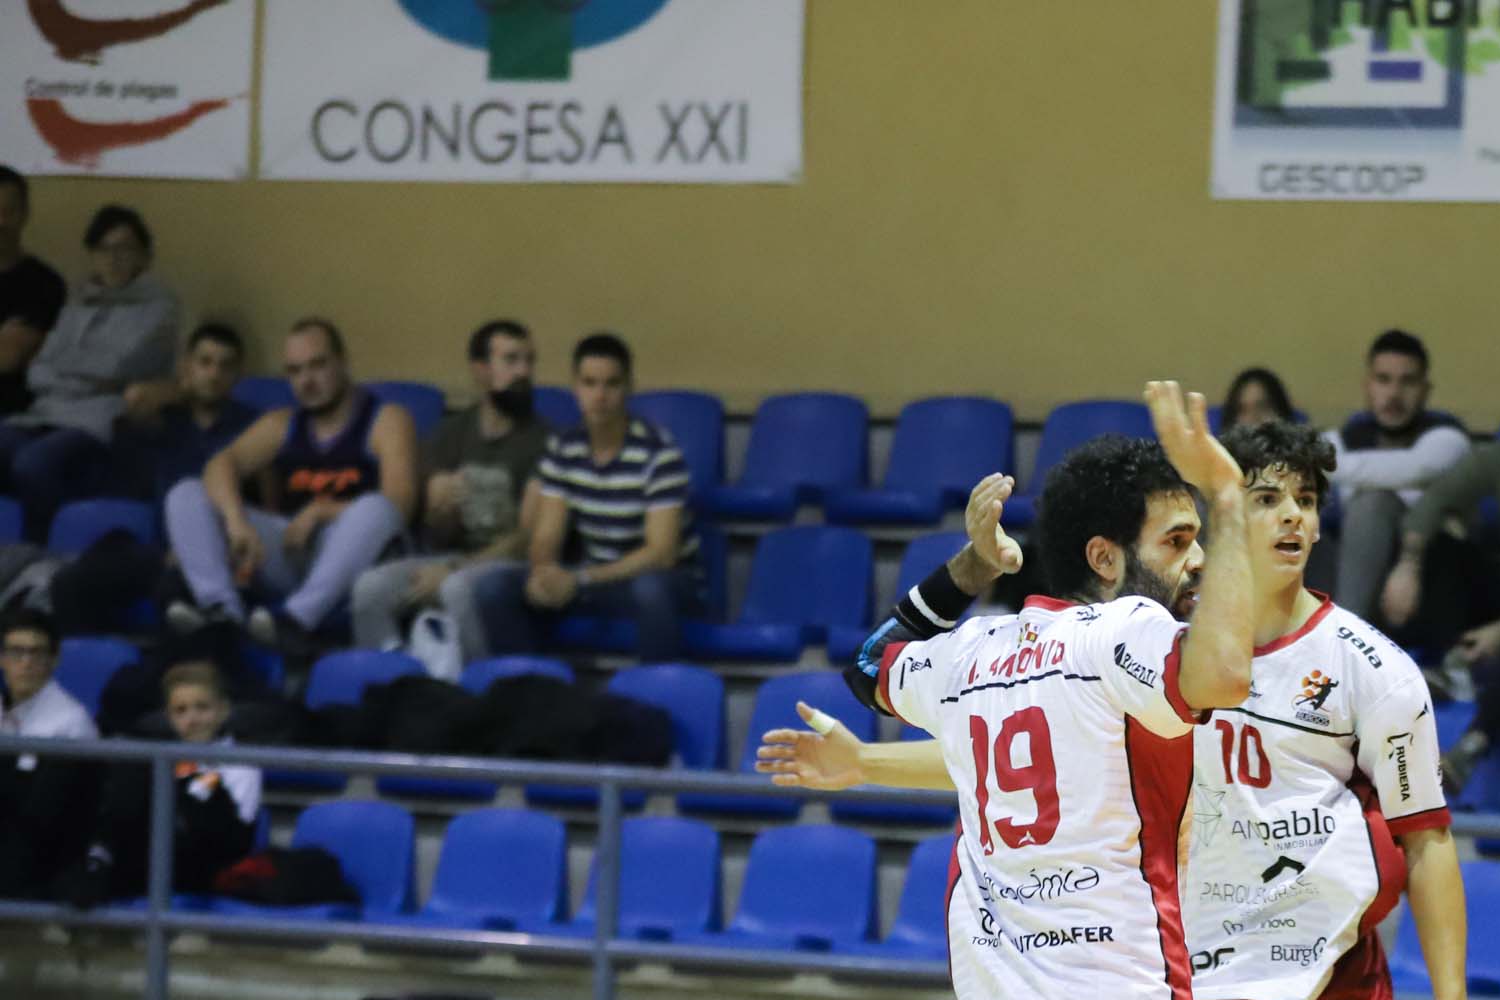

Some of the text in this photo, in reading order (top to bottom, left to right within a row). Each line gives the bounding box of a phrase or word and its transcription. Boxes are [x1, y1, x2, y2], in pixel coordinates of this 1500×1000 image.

[310, 99, 749, 163] CONGESA XXI
[1258, 164, 1425, 196] GESCOOP
[1337, 626, 1383, 669] gala
[970, 706, 1061, 856] 19
[1215, 719, 1272, 789] 10
[1395, 745, 1411, 802] RUBIERA
[972, 926, 1115, 953] TOYO UTOBAFER
